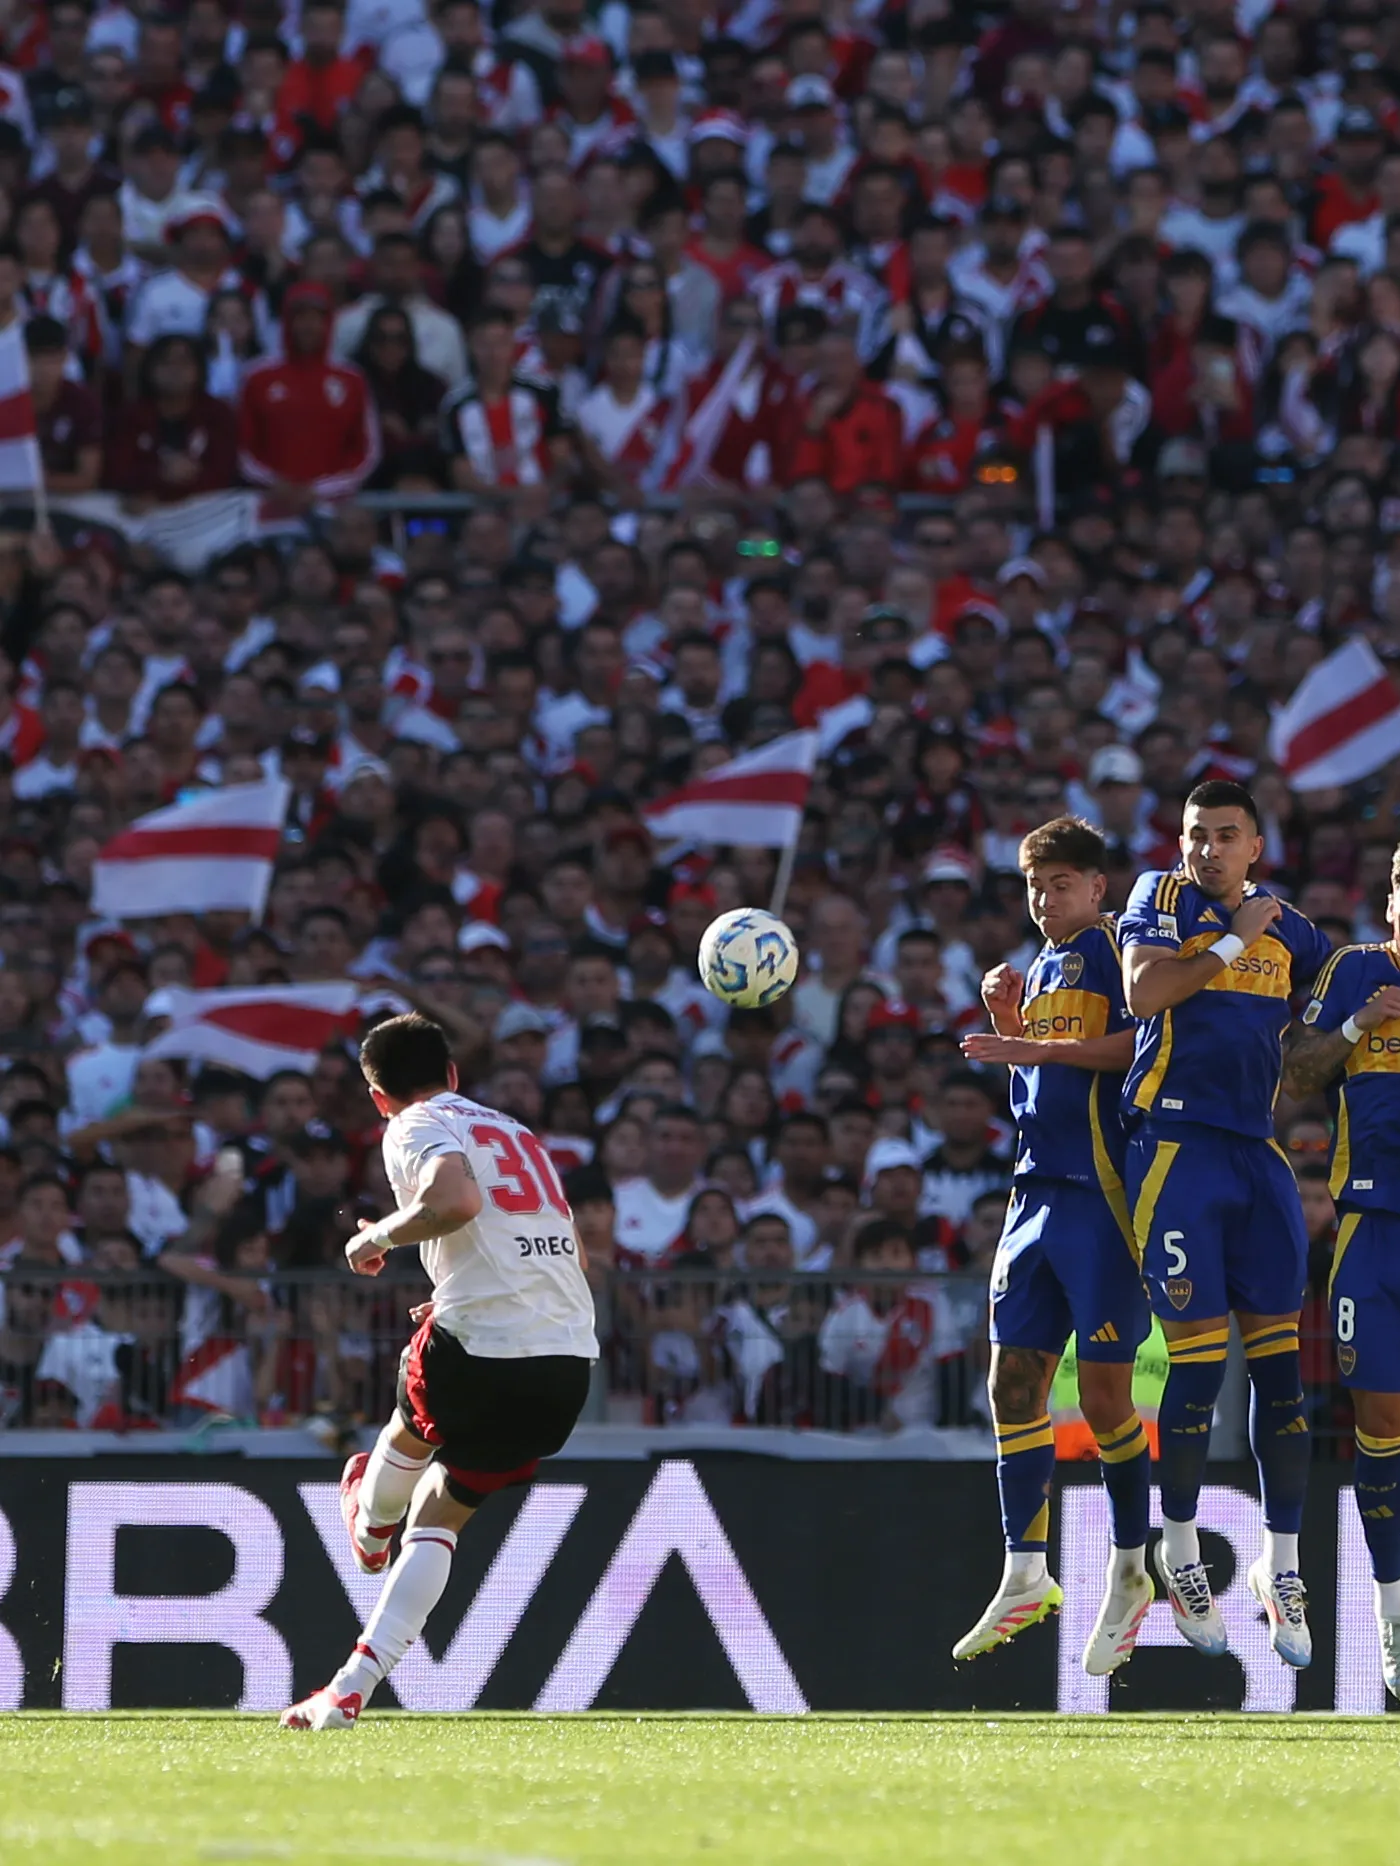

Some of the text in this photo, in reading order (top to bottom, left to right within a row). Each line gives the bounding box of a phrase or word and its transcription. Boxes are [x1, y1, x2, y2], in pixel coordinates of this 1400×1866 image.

[467, 1123, 573, 1219] 30
[1162, 1230, 1188, 1277] 5
[1337, 1296, 1356, 1342] 8
[0, 1459, 812, 1714] BVA
